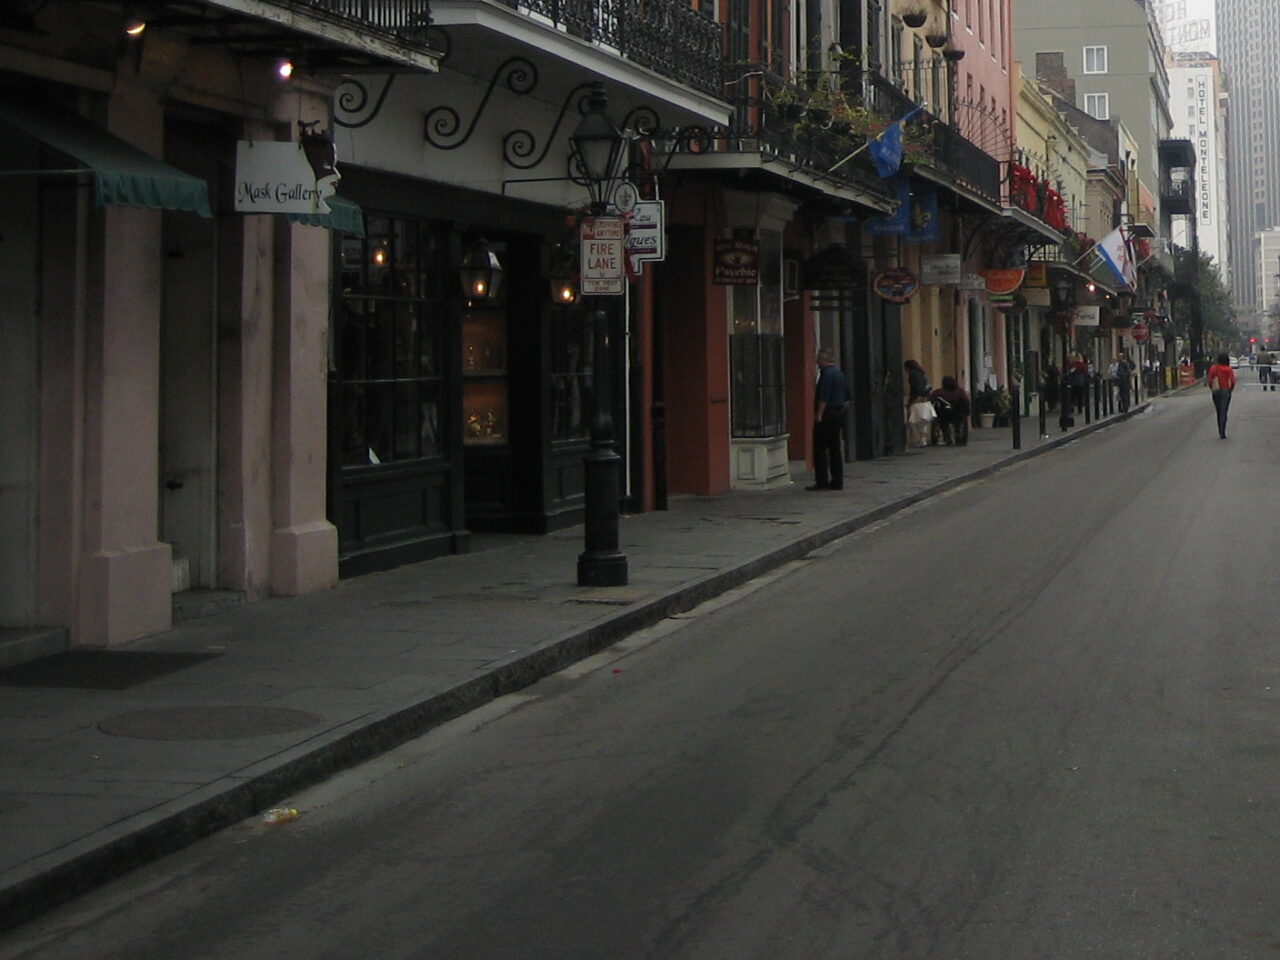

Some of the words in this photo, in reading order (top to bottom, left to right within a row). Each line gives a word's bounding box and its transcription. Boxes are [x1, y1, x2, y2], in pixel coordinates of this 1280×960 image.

[1198, 80, 1206, 125] HOTEL
[1199, 130, 1209, 219] MONTELEONE
[238, 181, 272, 204] Mask
[275, 182, 322, 209] Gallery
[588, 257, 617, 270] LANE
[590, 243, 615, 256] FIRE
